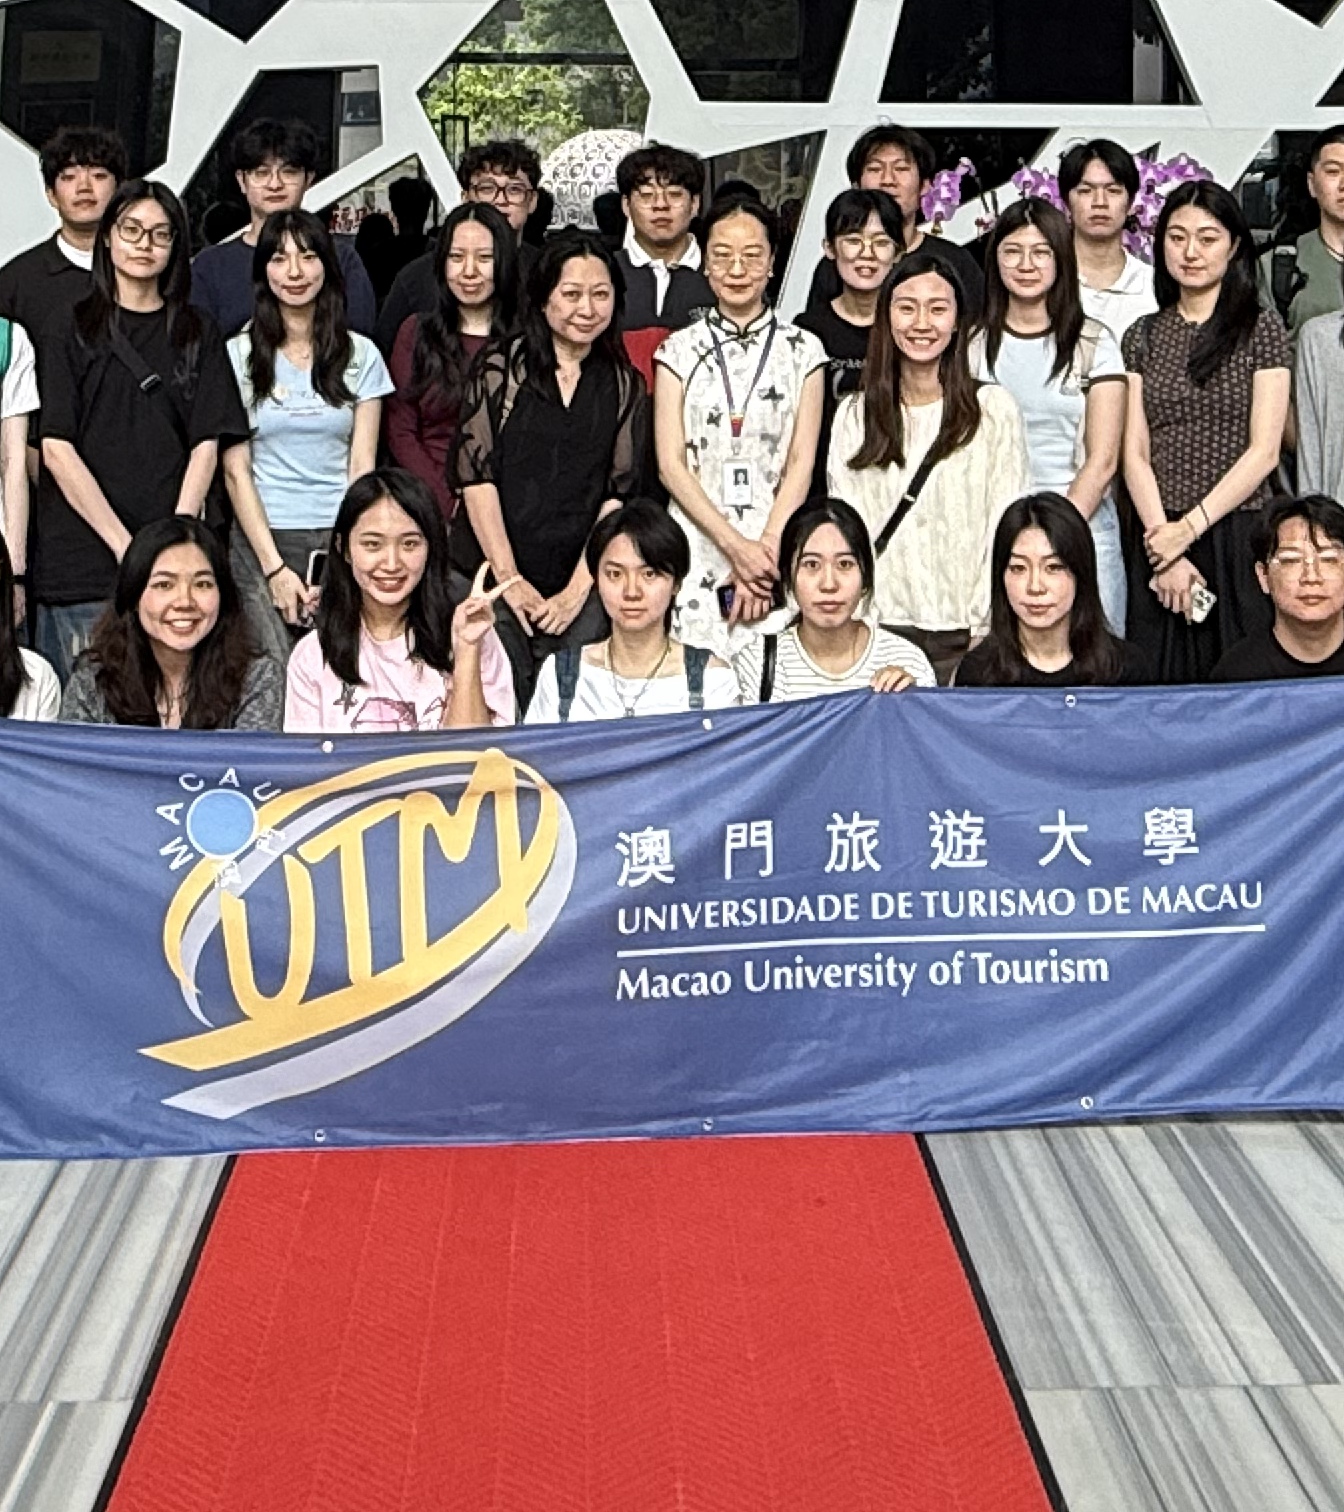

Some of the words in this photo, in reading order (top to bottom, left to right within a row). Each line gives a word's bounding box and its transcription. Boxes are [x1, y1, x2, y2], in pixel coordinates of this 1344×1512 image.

[155, 767, 282, 871] MACAU
[615, 807, 1200, 888] 澳門旅遊大學
[221, 750, 529, 1010] UTM
[617, 892, 861, 935] UNIVERSIDADE
[871, 891, 913, 921] DE
[921, 887, 1076, 919] TURISMO
[1087, 886, 1131, 916] DE
[1141, 881, 1263, 914] MACAU
[615, 967, 732, 1001] Macao
[744, 952, 918, 997] University
[928, 950, 965, 985] of
[970, 948, 1110, 985] Tourism
